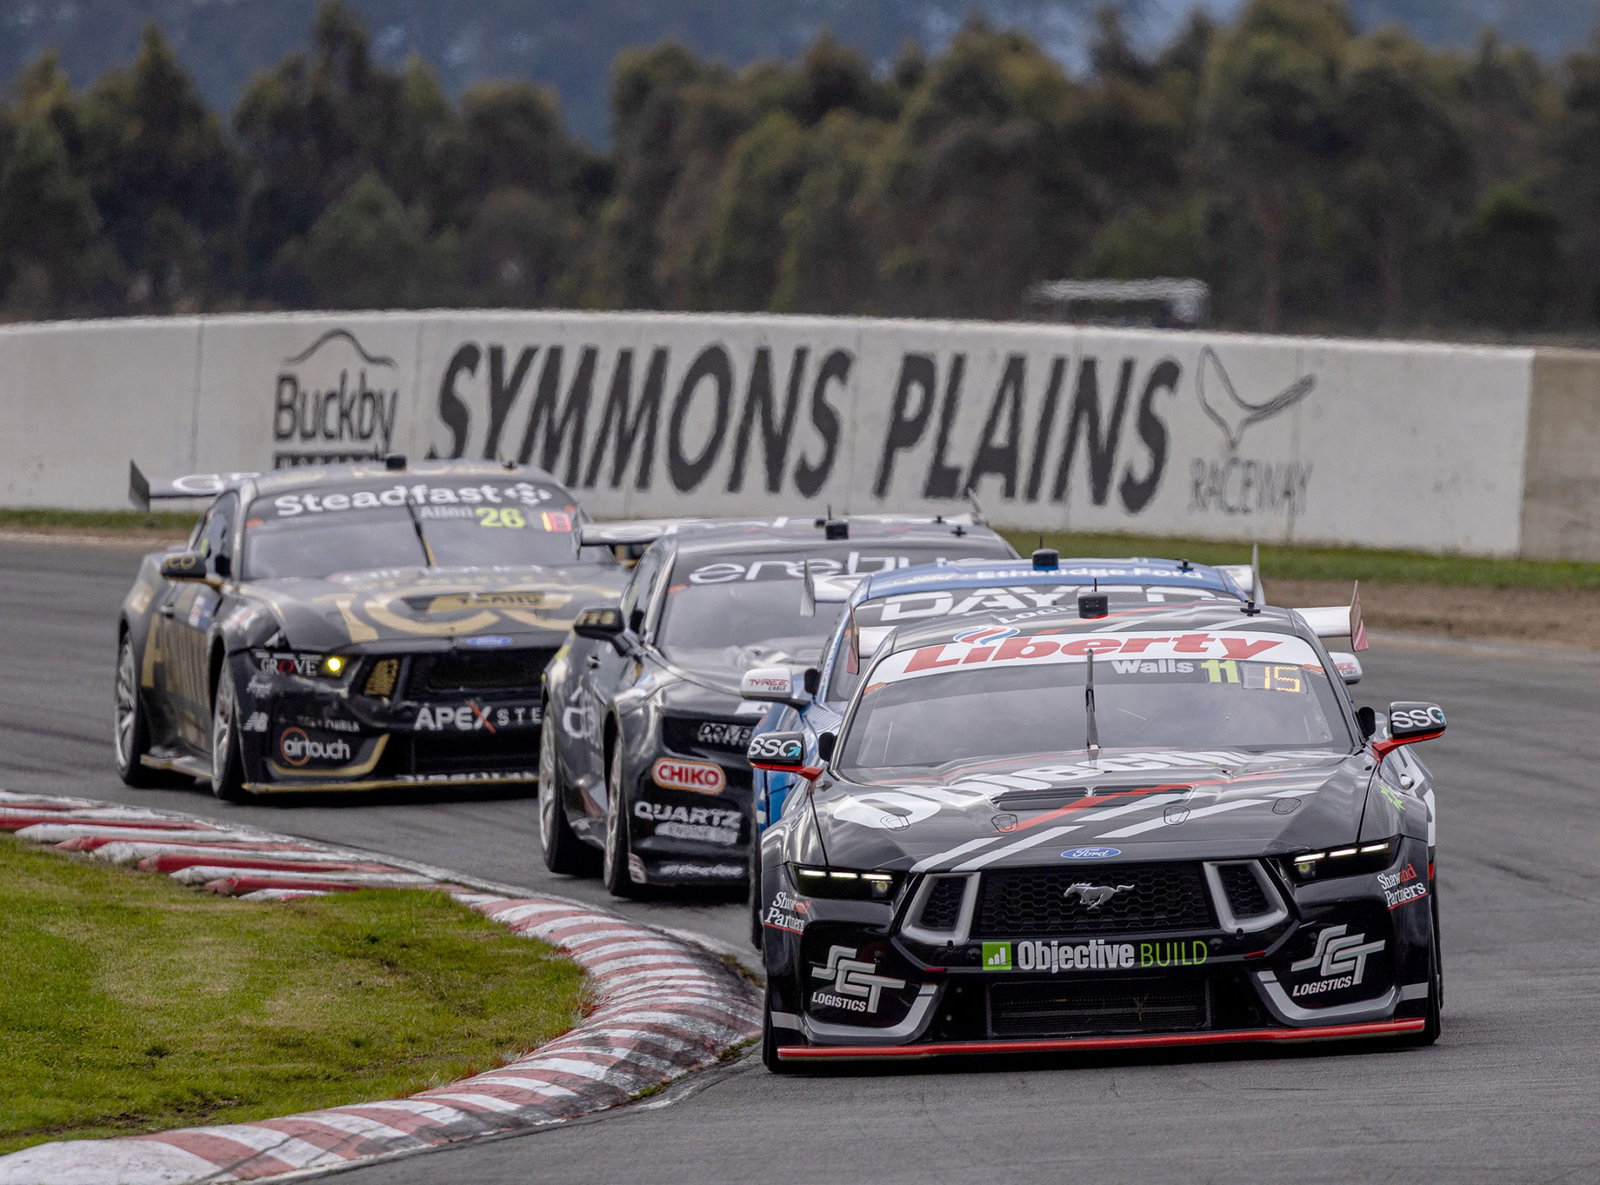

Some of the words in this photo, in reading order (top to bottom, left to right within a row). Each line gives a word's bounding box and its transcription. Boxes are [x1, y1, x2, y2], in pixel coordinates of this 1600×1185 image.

[273, 367, 398, 456] Buckby
[425, 340, 854, 498] SYMMONS
[873, 351, 1184, 515] PLAINS
[274, 484, 503, 517] Steadfast
[475, 506, 526, 529] 26
[903, 633, 1284, 673] Liberty
[261, 657, 319, 676] GROVE
[1110, 659, 1194, 675] Walls
[1201, 659, 1240, 684] 11
[1264, 665, 1301, 693] 15
[413, 701, 497, 735] APEX
[283, 737, 350, 760] airtouch
[658, 764, 719, 787] CHIKO
[634, 801, 742, 829] QUARTZ
[1072, 848, 1110, 859] Ford
[1018, 938, 1135, 973] Objective
[1140, 940, 1208, 967] BUILD
[1293, 975, 1353, 998] LOGISTICS
[811, 991, 867, 1013] LOGISTICS
